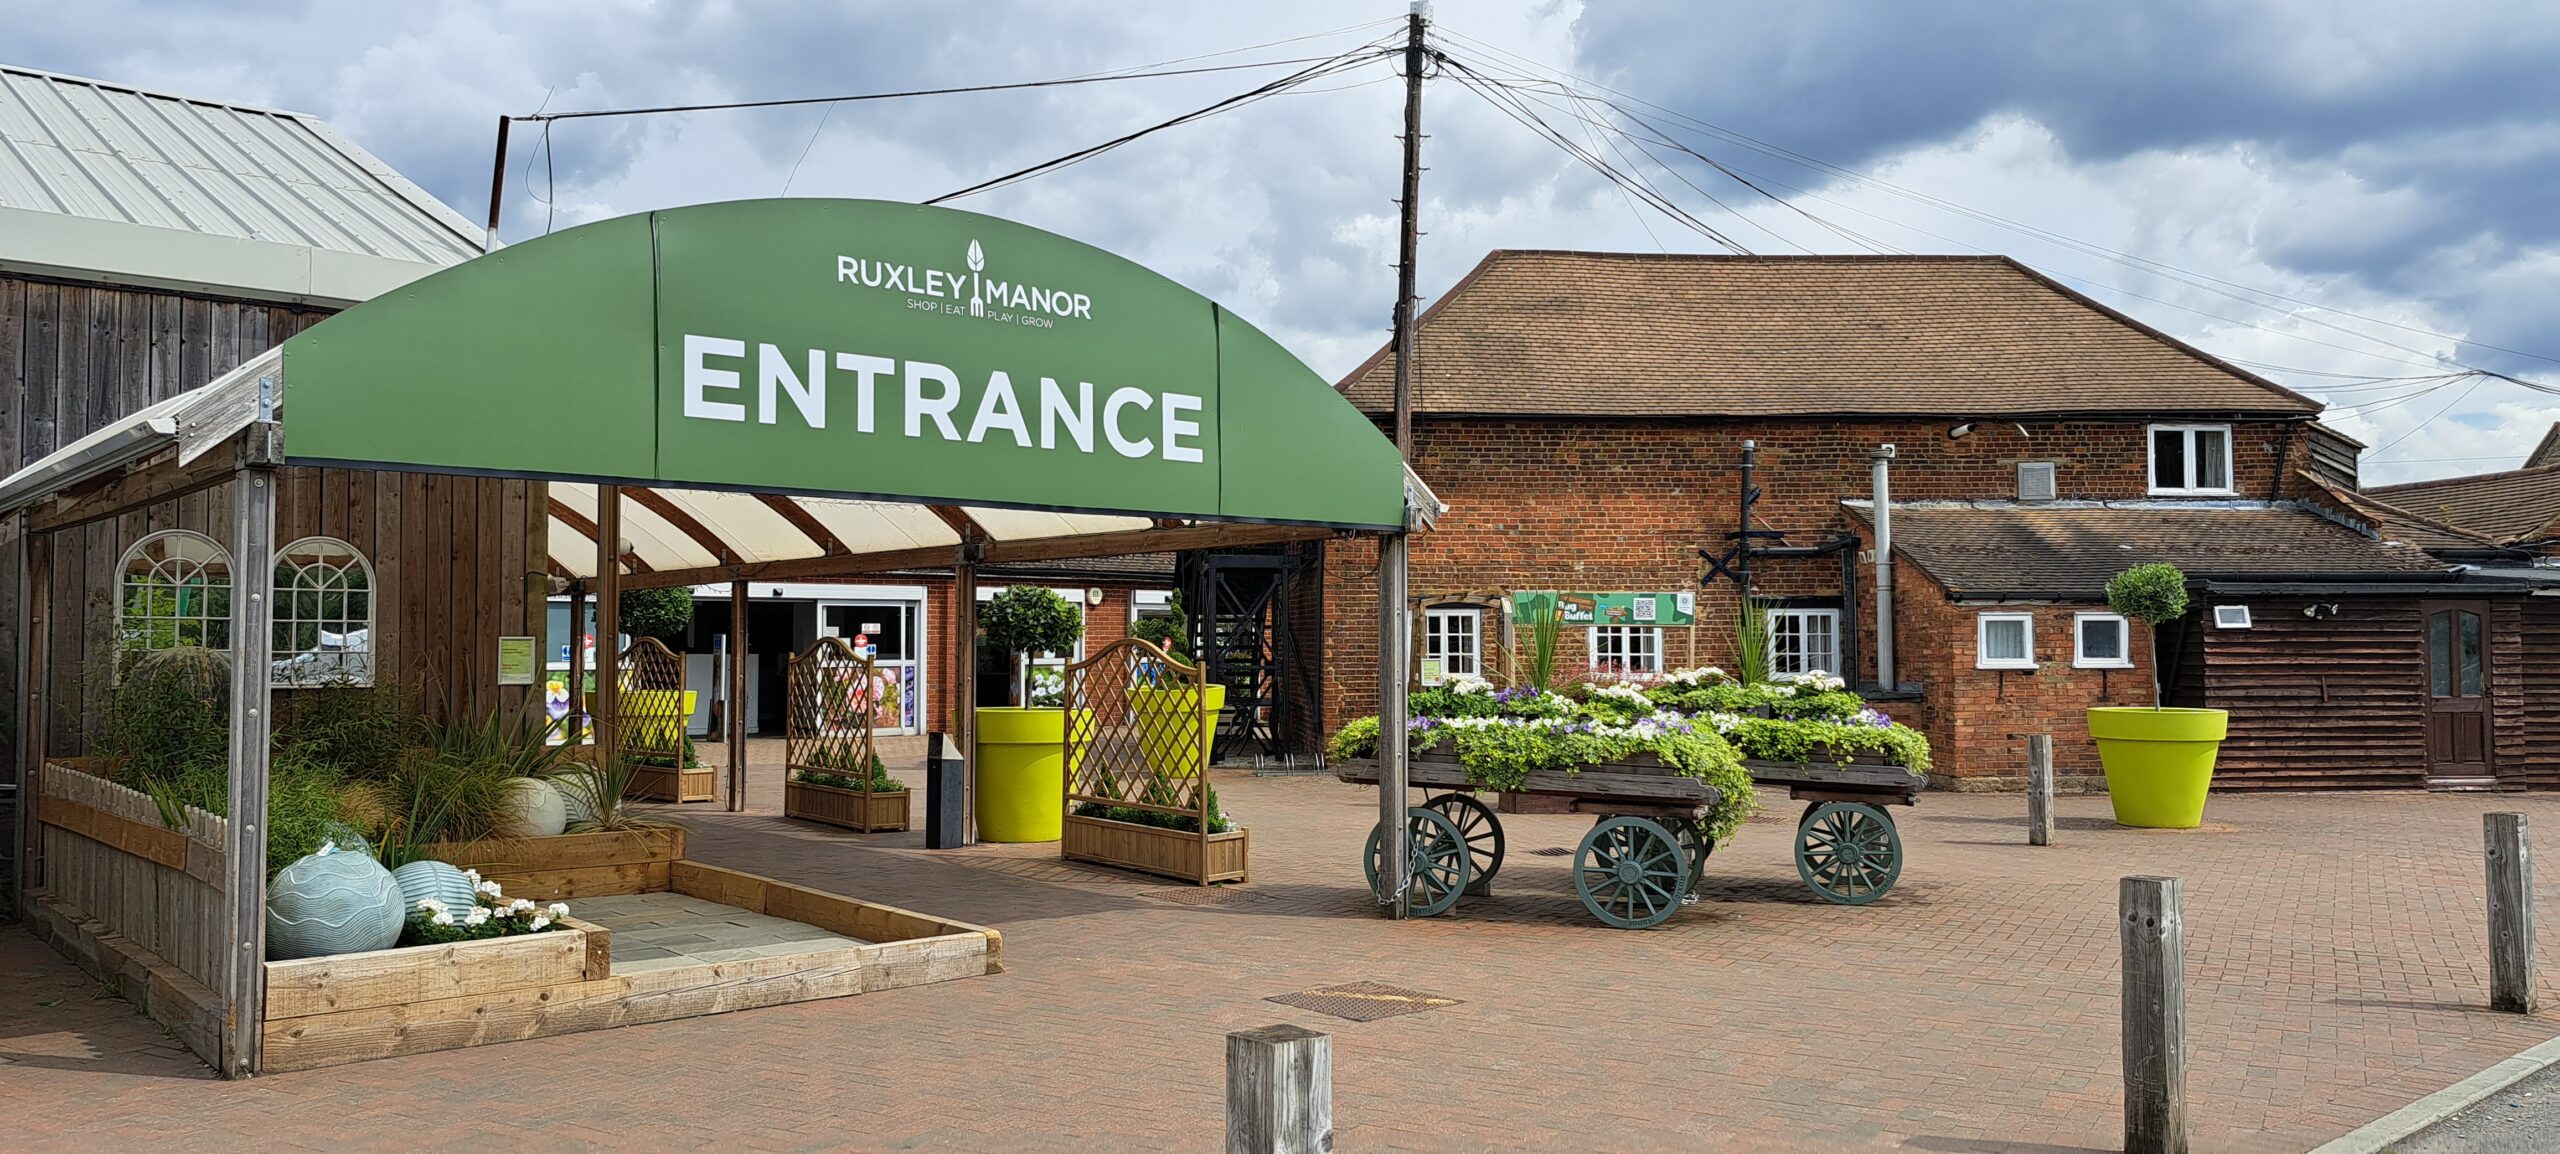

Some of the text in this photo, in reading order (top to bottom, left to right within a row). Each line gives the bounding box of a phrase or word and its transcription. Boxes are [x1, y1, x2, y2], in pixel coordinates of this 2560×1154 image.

[837, 255, 1092, 320] RUXLEY MANOR
[906, 298, 1054, 329] SHOP EAT PLAY GROW
[683, 334, 1204, 464] ENTRANCE
[1564, 609, 1594, 621] Buffet
